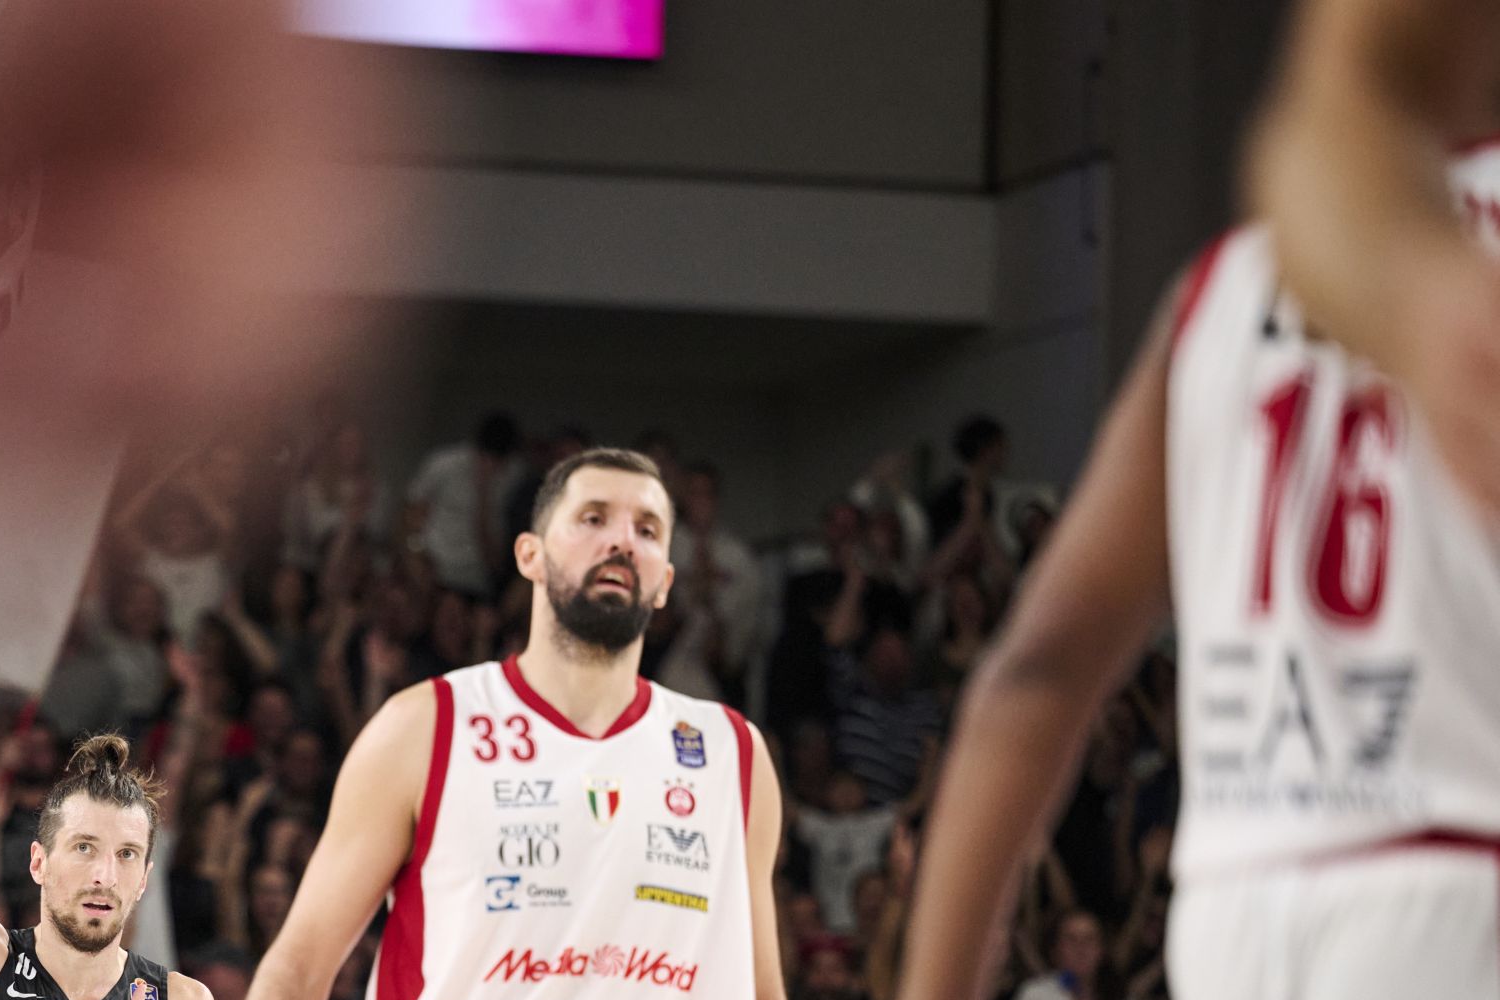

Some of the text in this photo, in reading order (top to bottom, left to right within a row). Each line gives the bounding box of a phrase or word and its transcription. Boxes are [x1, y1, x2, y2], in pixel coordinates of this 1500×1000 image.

[1250, 372, 1395, 625] 16
[468, 714, 537, 763] 33
[493, 780, 554, 802] EA7
[624, 946, 698, 993] Word
